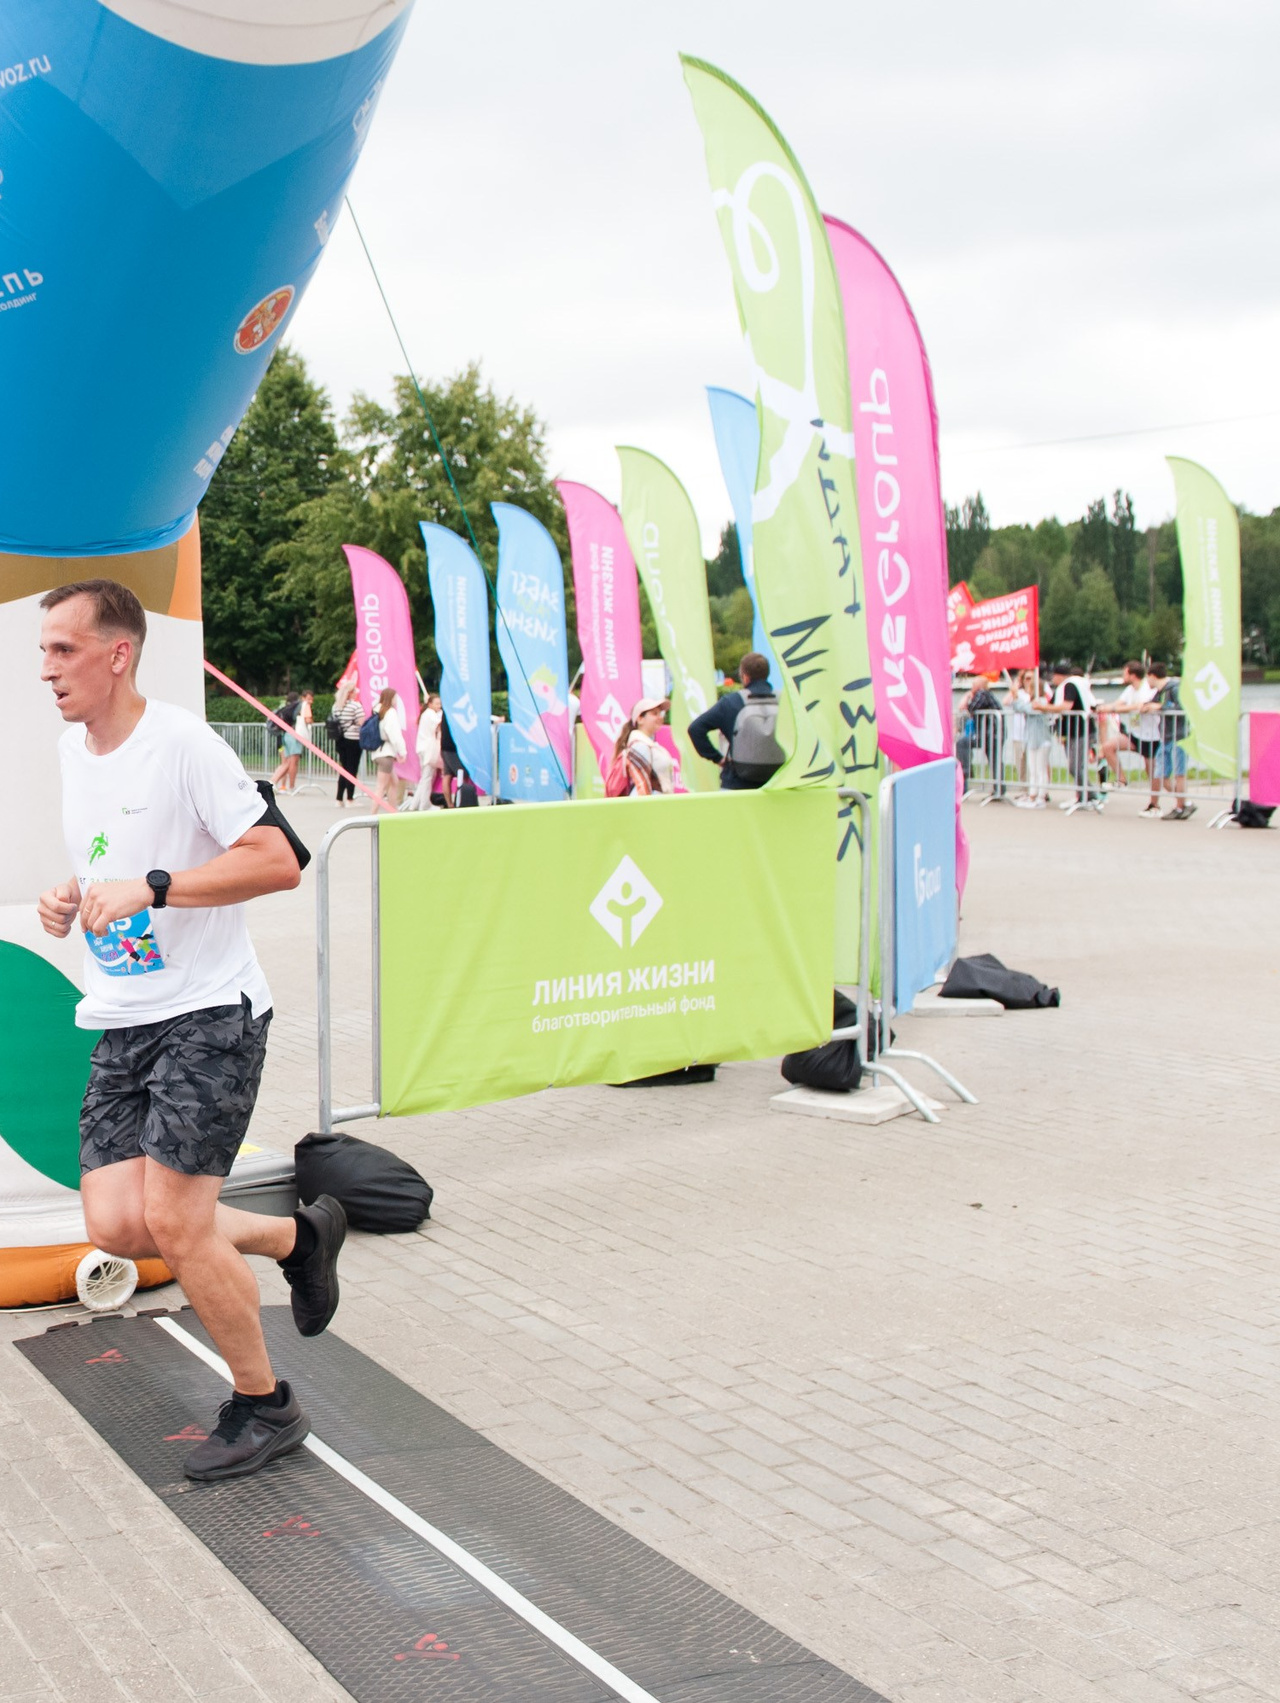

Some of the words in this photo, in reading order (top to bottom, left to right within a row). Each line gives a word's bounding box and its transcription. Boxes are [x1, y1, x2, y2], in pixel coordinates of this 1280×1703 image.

[532, 970, 622, 1007] ЛИНИЯ
[627, 959, 716, 994] ЖИЗНИ
[532, 997, 677, 1034] благотворительный
[679, 994, 716, 1016] фонд
